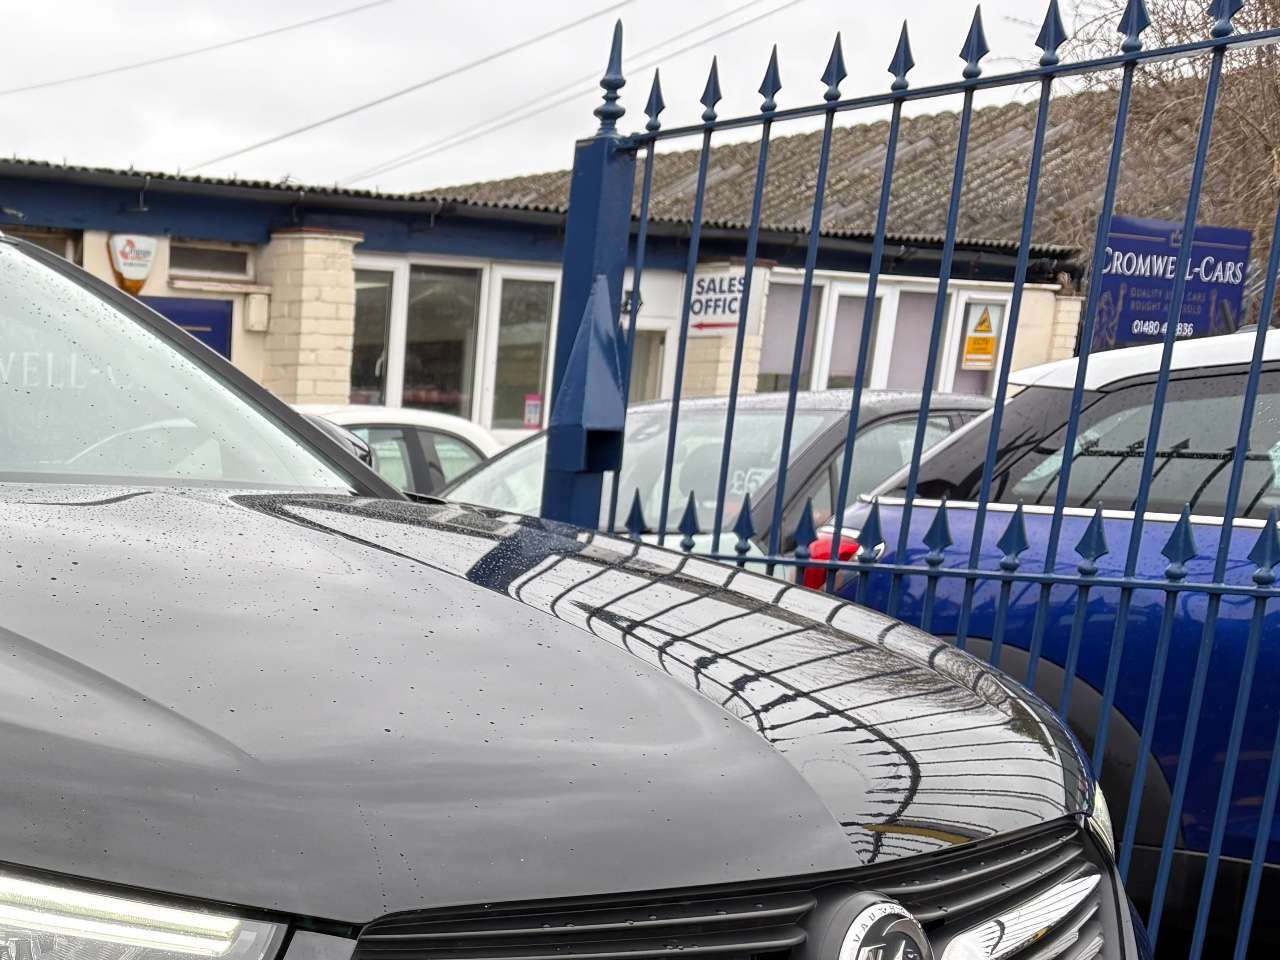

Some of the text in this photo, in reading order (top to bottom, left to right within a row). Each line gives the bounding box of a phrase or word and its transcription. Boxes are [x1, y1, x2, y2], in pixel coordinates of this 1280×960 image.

[1102, 246, 1244, 285] CROMWEL-CARS
[696, 277, 745, 296] SALES
[691, 297, 740, 316] OFFIC
[1131, 319, 1194, 337] 01480 4836
